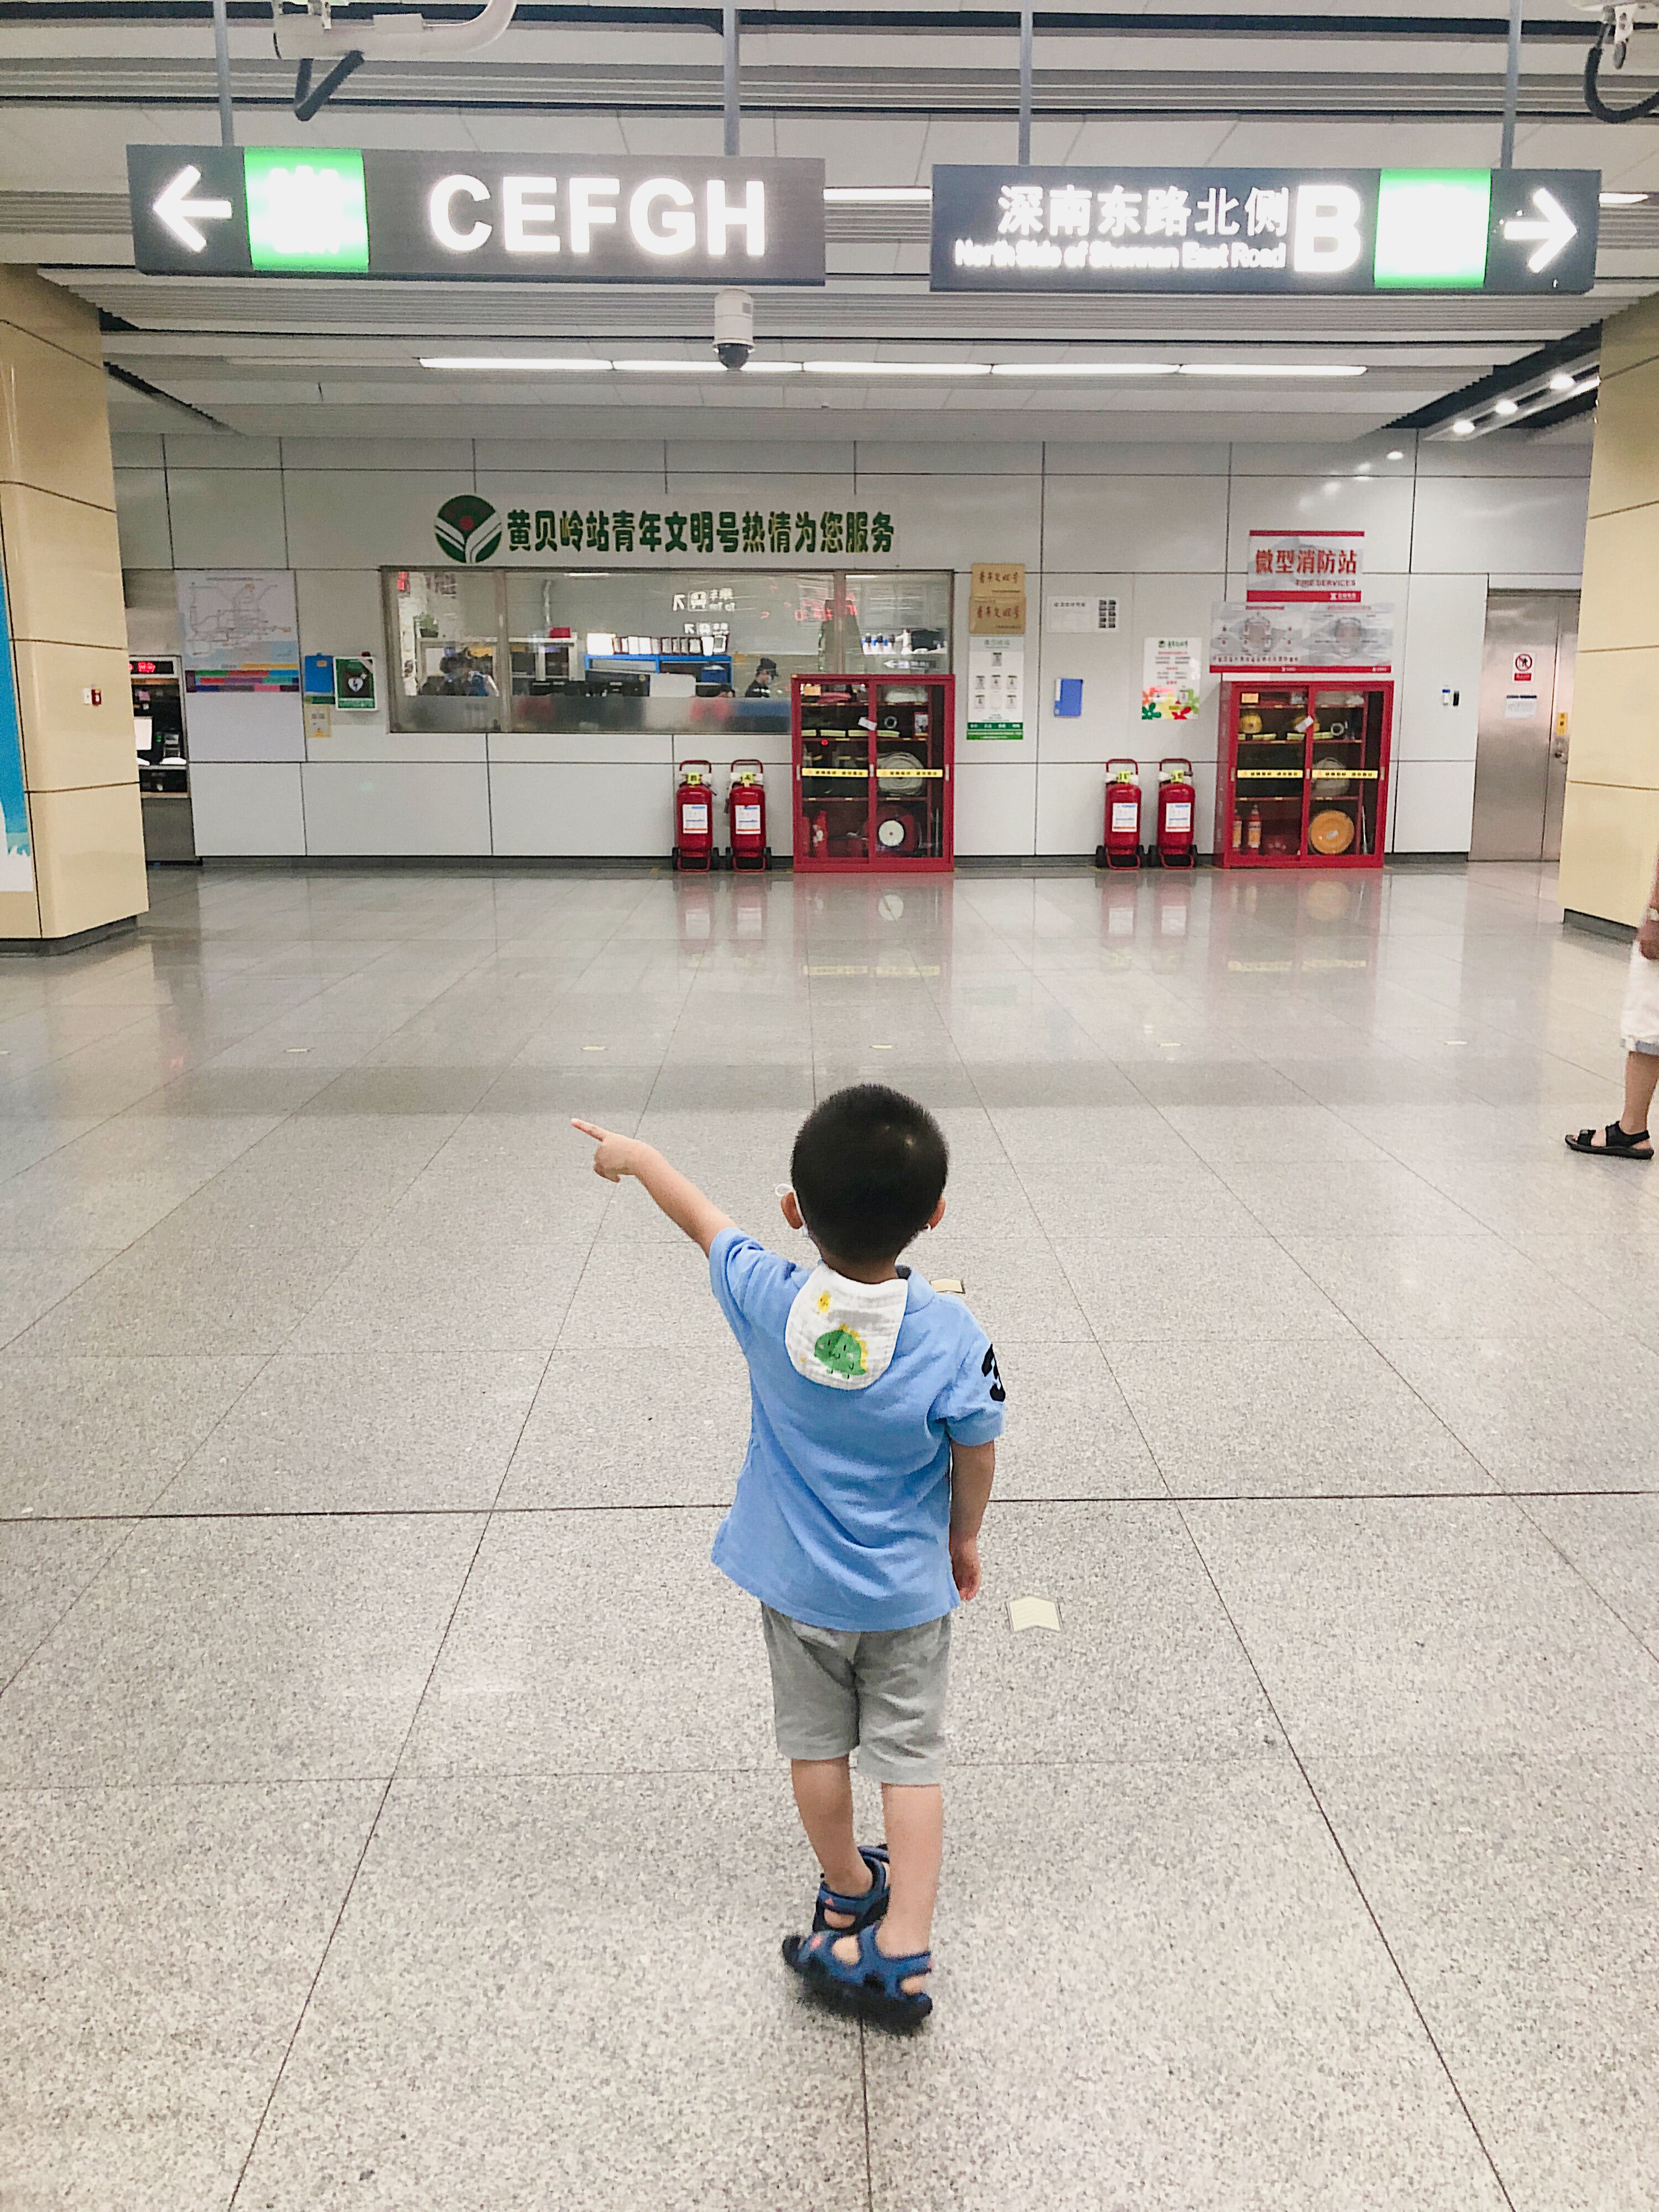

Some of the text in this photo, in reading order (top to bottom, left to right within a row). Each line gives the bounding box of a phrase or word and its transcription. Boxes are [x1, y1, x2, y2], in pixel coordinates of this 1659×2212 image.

[429, 174, 765, 255] CEFGH
[997, 185, 1289, 236] 深南东路北侧
[1294, 185, 1361, 272] B
[1231, 242, 1286, 268] Road
[507, 509, 894, 553] 黄贝岭站青年文明号热情为您服务
[1256, 549, 1357, 574] 微型消防站
